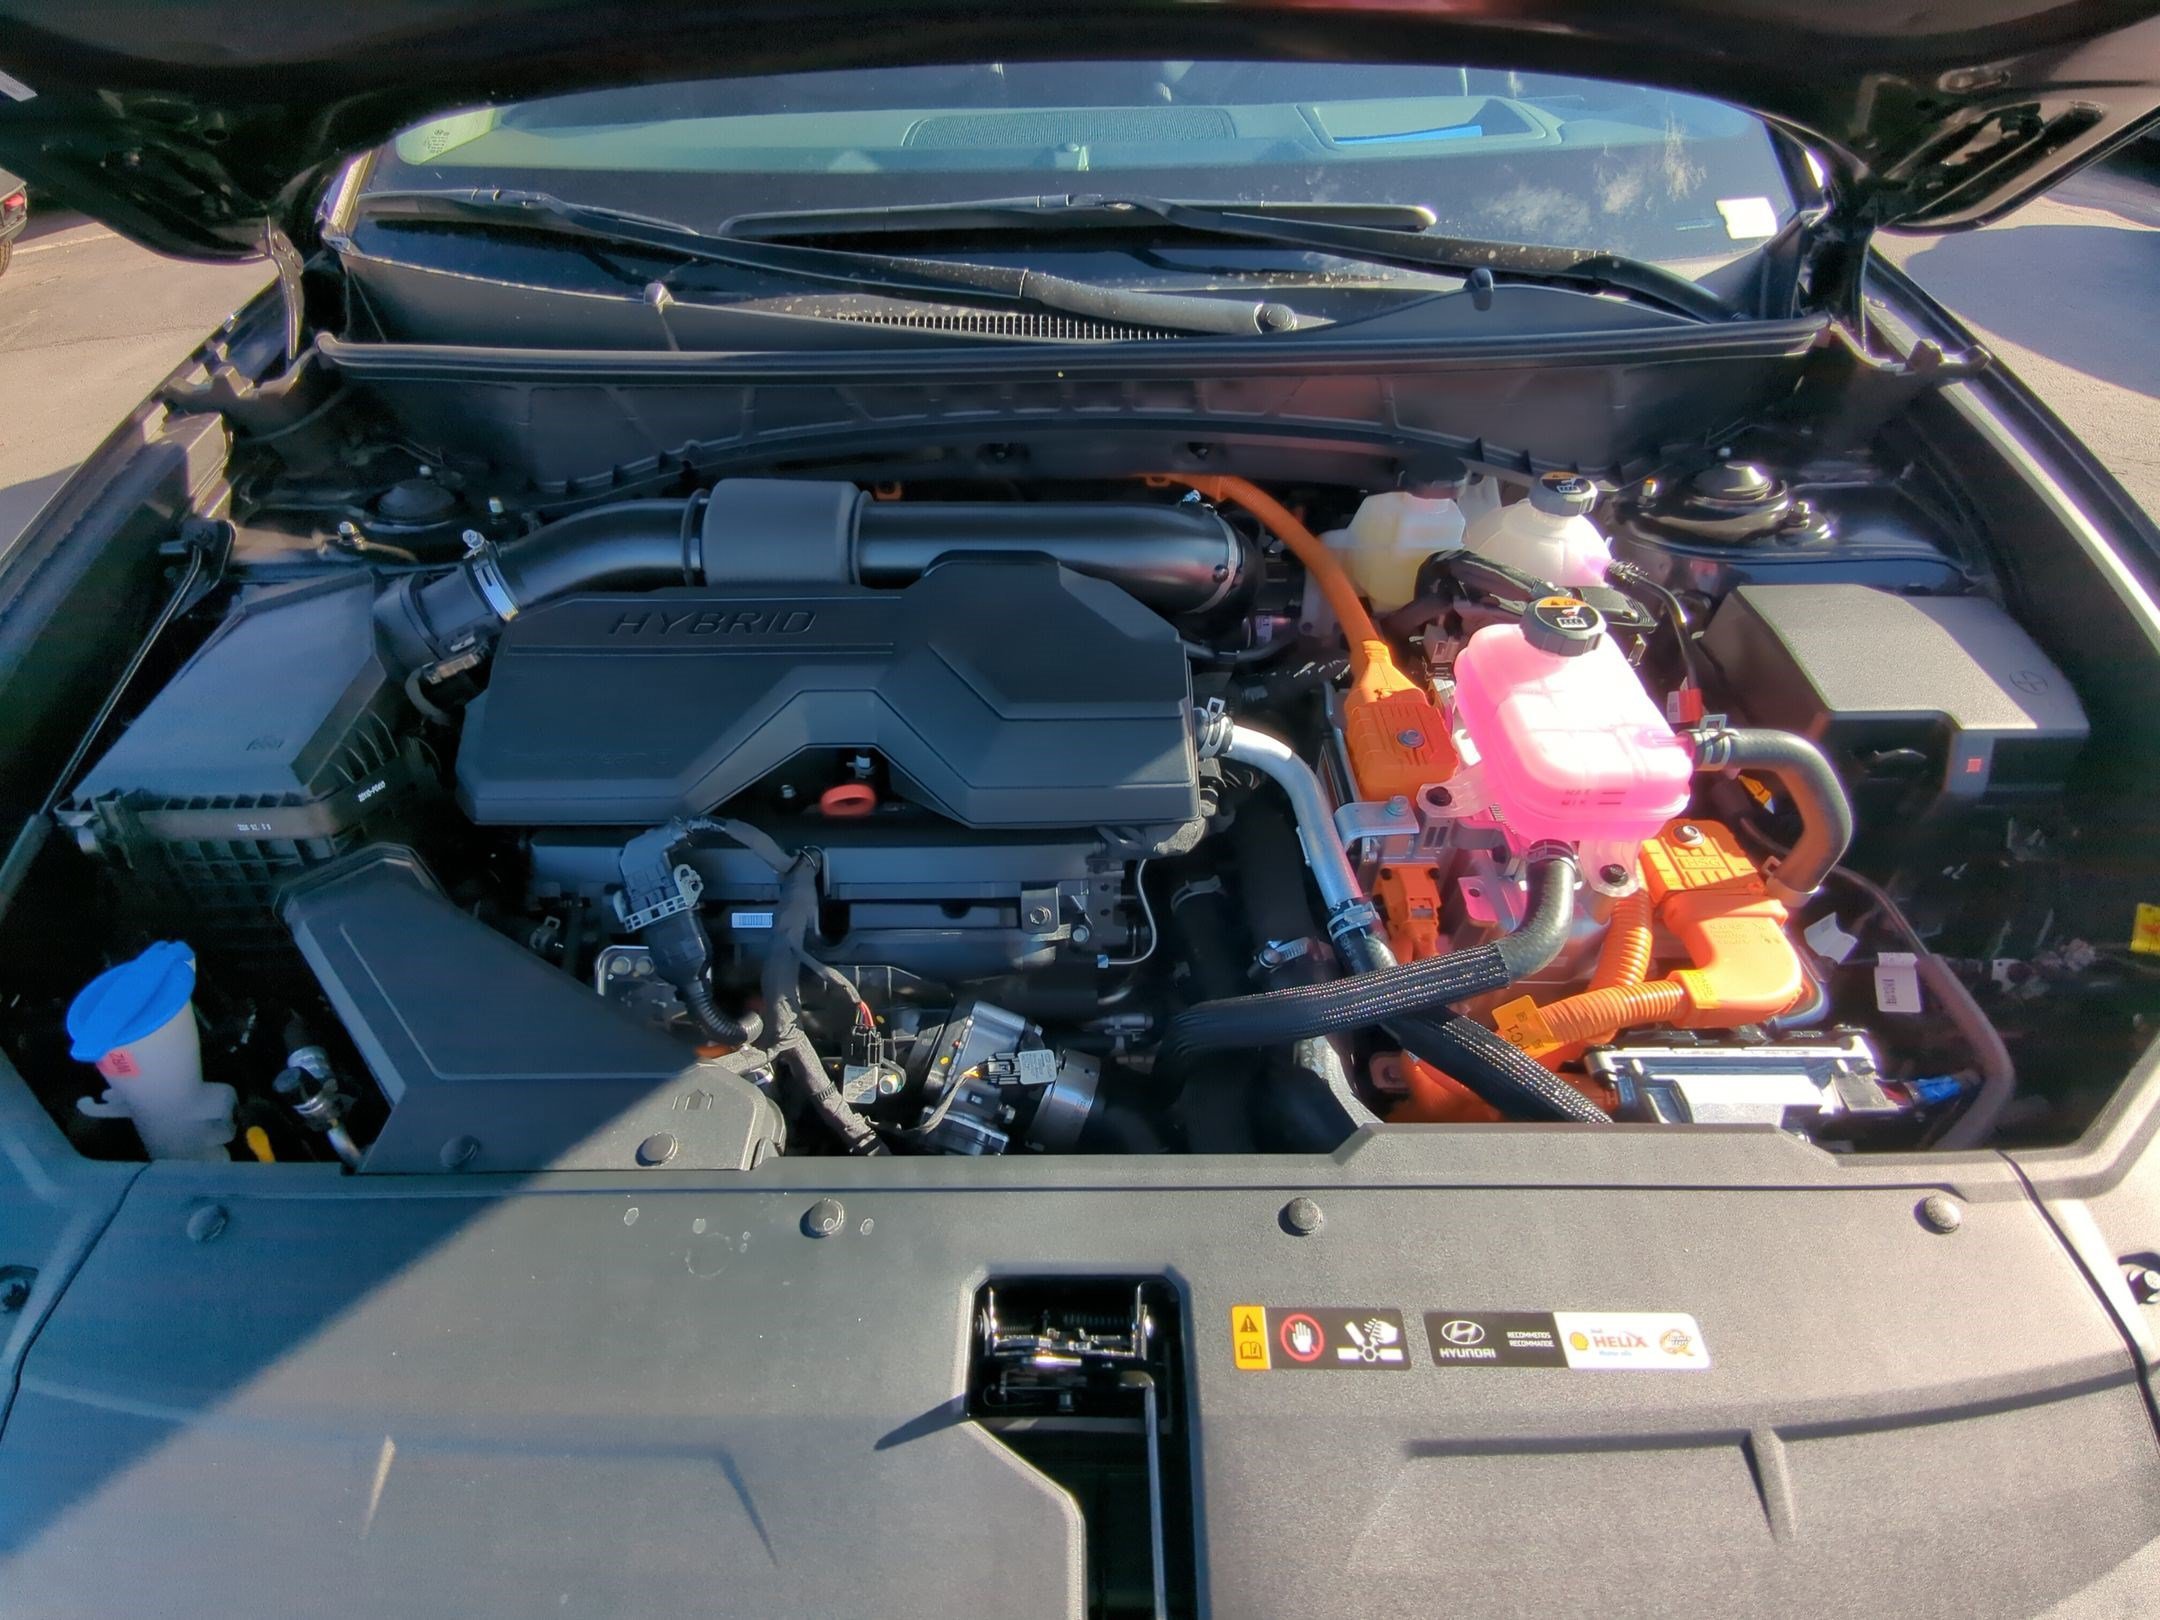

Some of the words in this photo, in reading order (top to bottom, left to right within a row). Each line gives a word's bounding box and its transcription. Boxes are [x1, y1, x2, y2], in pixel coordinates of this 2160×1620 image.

[608, 609, 818, 636] HYBRID
[1593, 1333, 1649, 1349] HELIX
[1439, 1347, 1497, 1359] HYUNDAI
